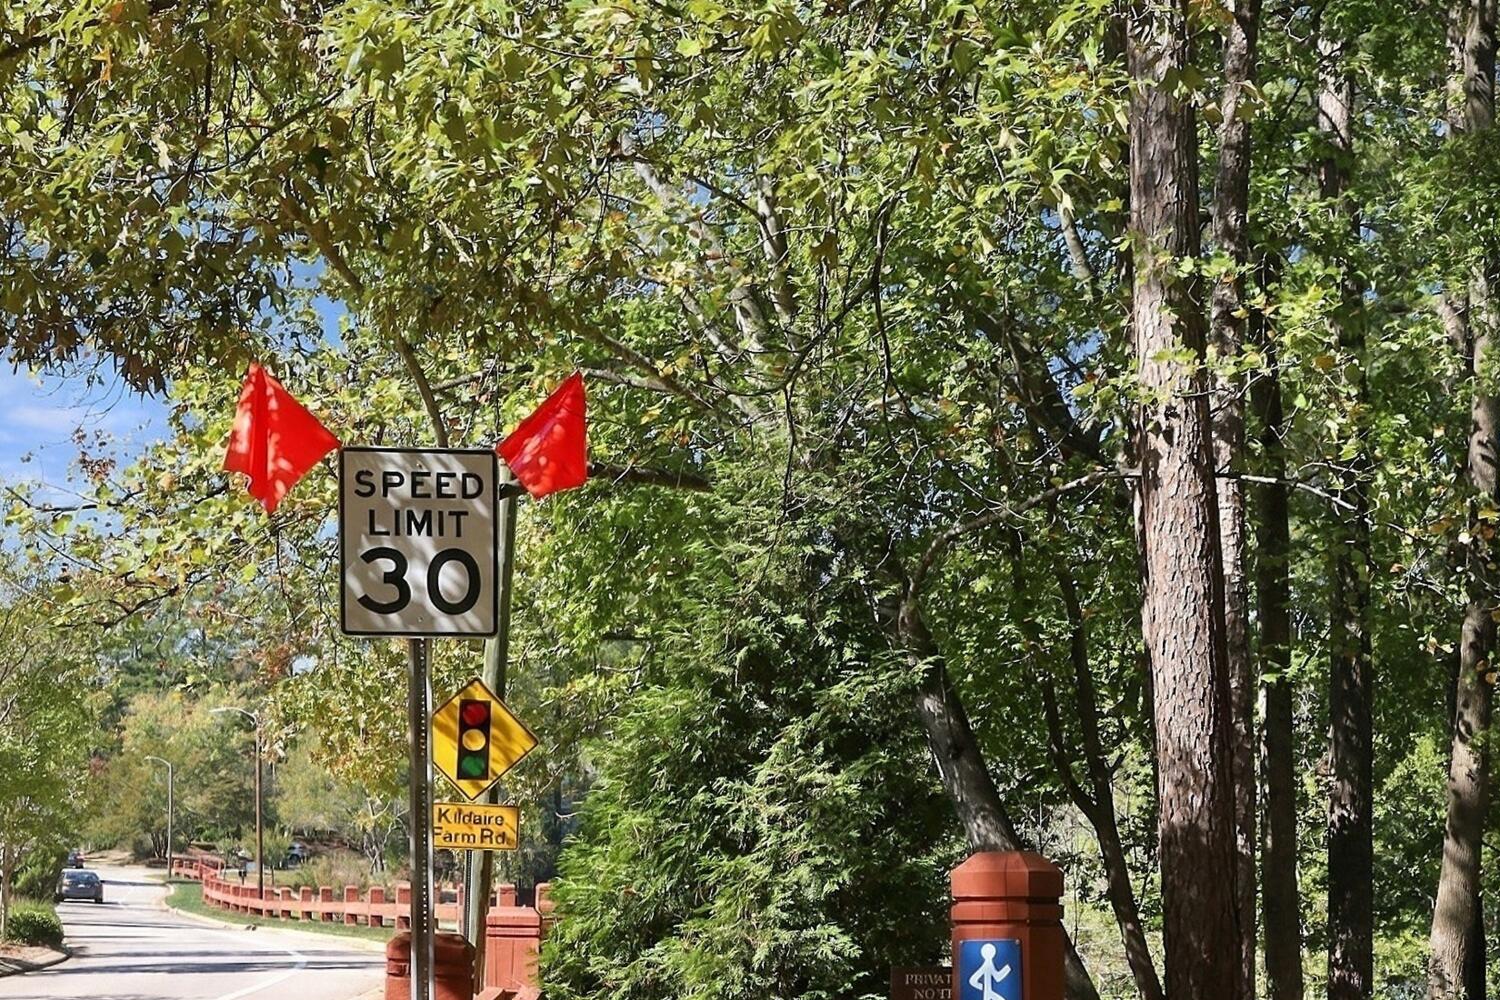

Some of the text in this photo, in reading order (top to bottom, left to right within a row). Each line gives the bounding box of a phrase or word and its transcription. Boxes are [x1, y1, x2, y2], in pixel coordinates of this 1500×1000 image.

[354, 469, 484, 500] SPEED
[368, 509, 469, 538] LIMIT
[357, 546, 481, 616] 30
[437, 807, 504, 826] Kildaire
[433, 826, 476, 844] Farm
[905, 974, 952, 985] PRIVAT
